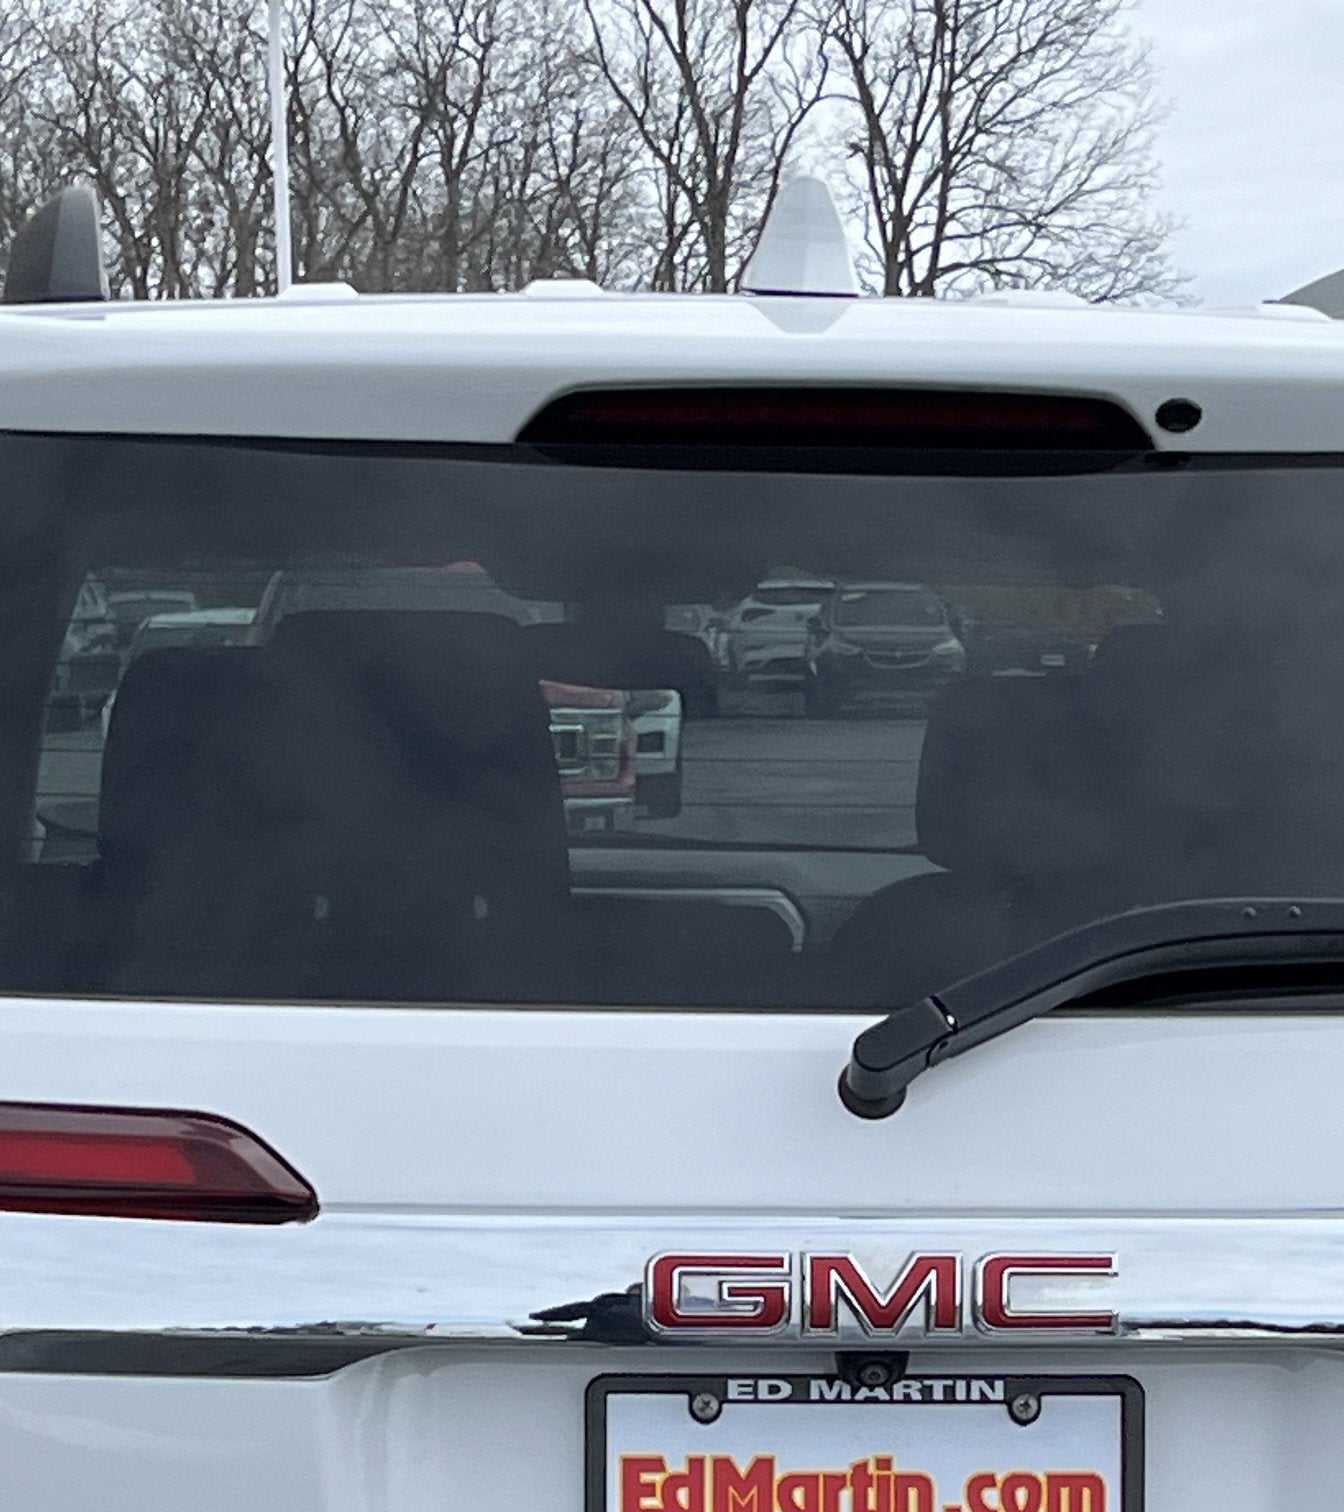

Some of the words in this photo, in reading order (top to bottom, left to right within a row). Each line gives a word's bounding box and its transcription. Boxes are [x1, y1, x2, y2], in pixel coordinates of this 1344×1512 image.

[645, 1250, 1119, 1338] GMC
[727, 1380, 793, 1401] ED
[809, 1380, 1007, 1402] MARTIN
